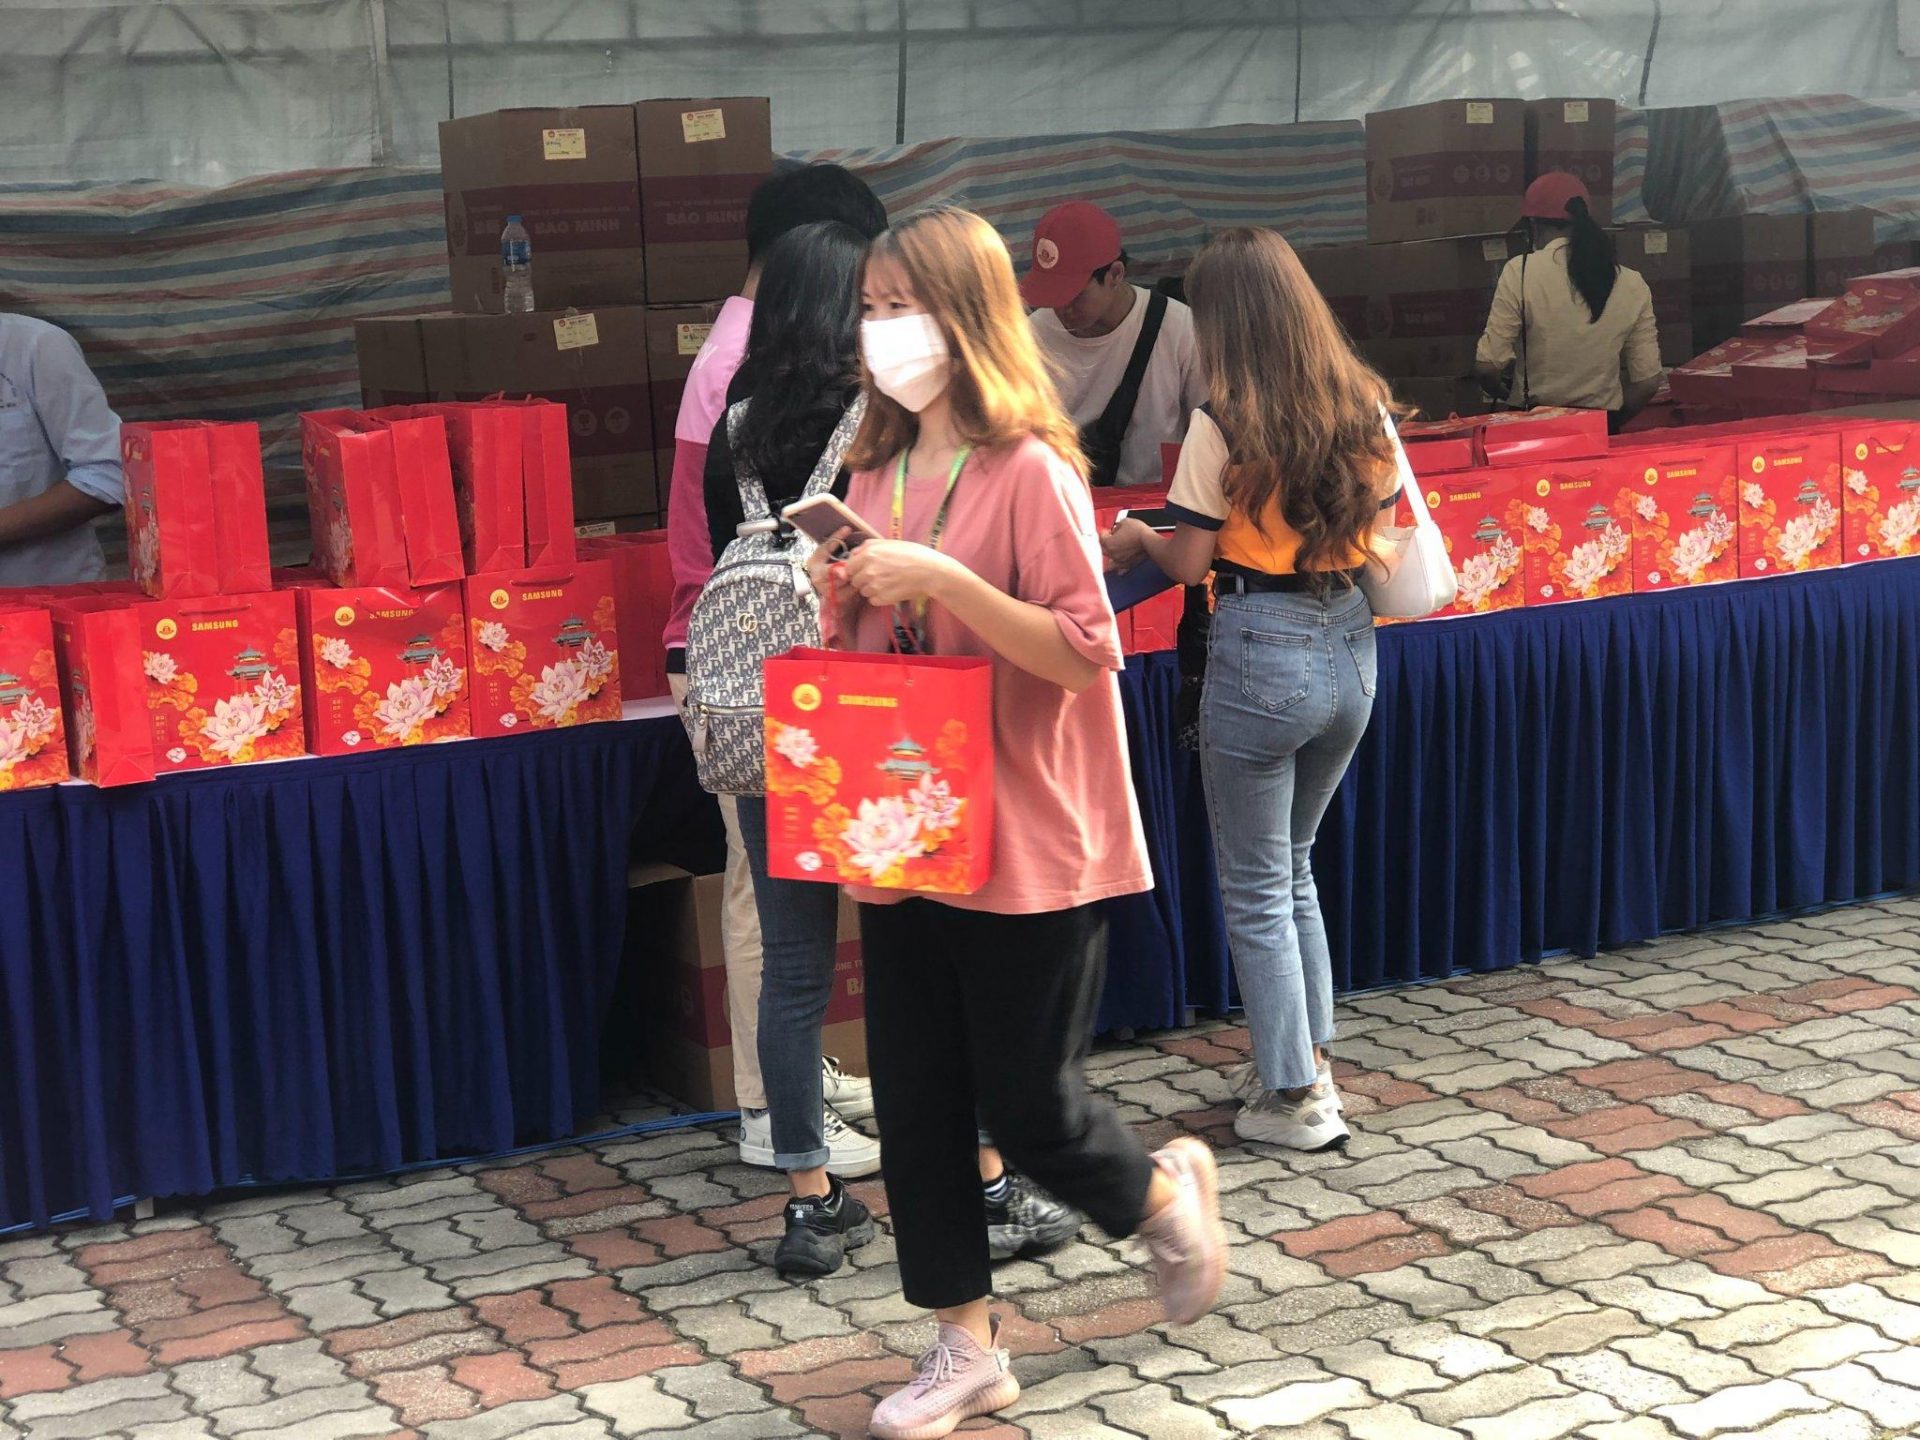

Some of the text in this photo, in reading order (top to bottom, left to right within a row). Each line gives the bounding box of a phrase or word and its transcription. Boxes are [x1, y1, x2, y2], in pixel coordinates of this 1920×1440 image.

[575, 218, 620, 233] MINH
[1560, 480, 1592, 490] SAMSUNG
[1449, 491, 1481, 502] SAMSUNG
[522, 589, 563, 601] SAMSUNG
[191, 619, 239, 632] SAMSUNG
